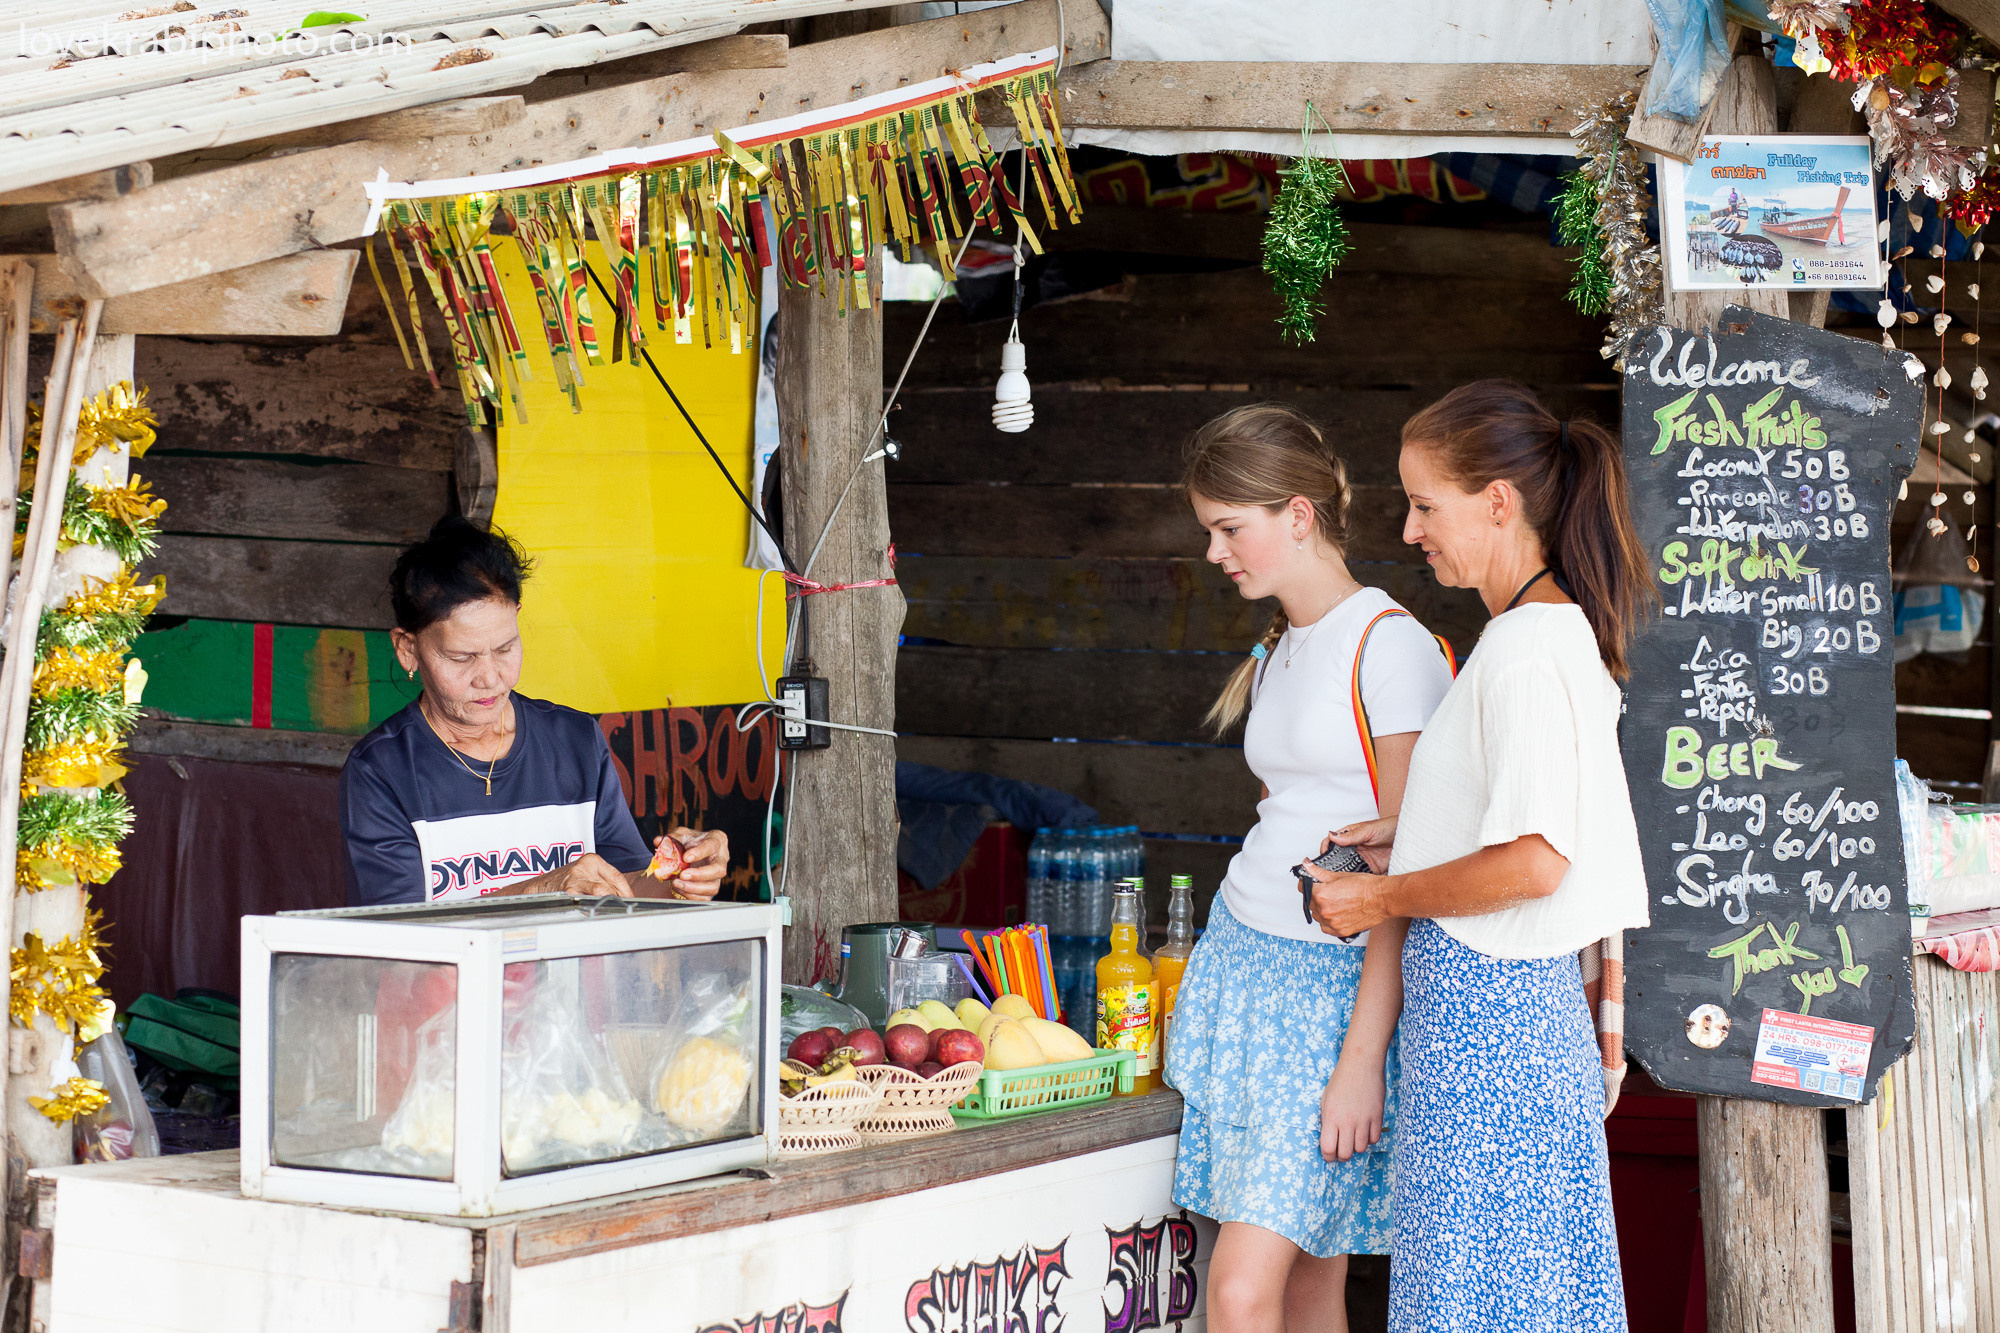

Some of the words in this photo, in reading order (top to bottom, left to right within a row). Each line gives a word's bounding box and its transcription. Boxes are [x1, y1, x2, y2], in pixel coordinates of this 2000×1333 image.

[1711, 164, 1766, 180] ตกปลา
[1767, 153, 1817, 170] Fullday
[1798, 171, 1842, 186] Fishing
[1844, 172, 1869, 186] Trip
[1650, 326, 1821, 389] Welcome
[1650, 388, 1744, 455] Fresh
[1742, 386, 1828, 450] Fruits
[1659, 539, 1742, 585] Soft
[1761, 573, 1824, 616] Small
[1762, 618, 1802, 658] Big
[1661, 726, 1804, 789] BEER
[1708, 921, 1821, 996] Thank
[1791, 967, 1837, 1015] you
[1763, 1031, 1775, 1039] 24
[1778, 1033, 1800, 1044] HRS.
[1796, 1031, 1821, 1040] MEDICAL
[1822, 1036, 1867, 1048] CONSULTATION
